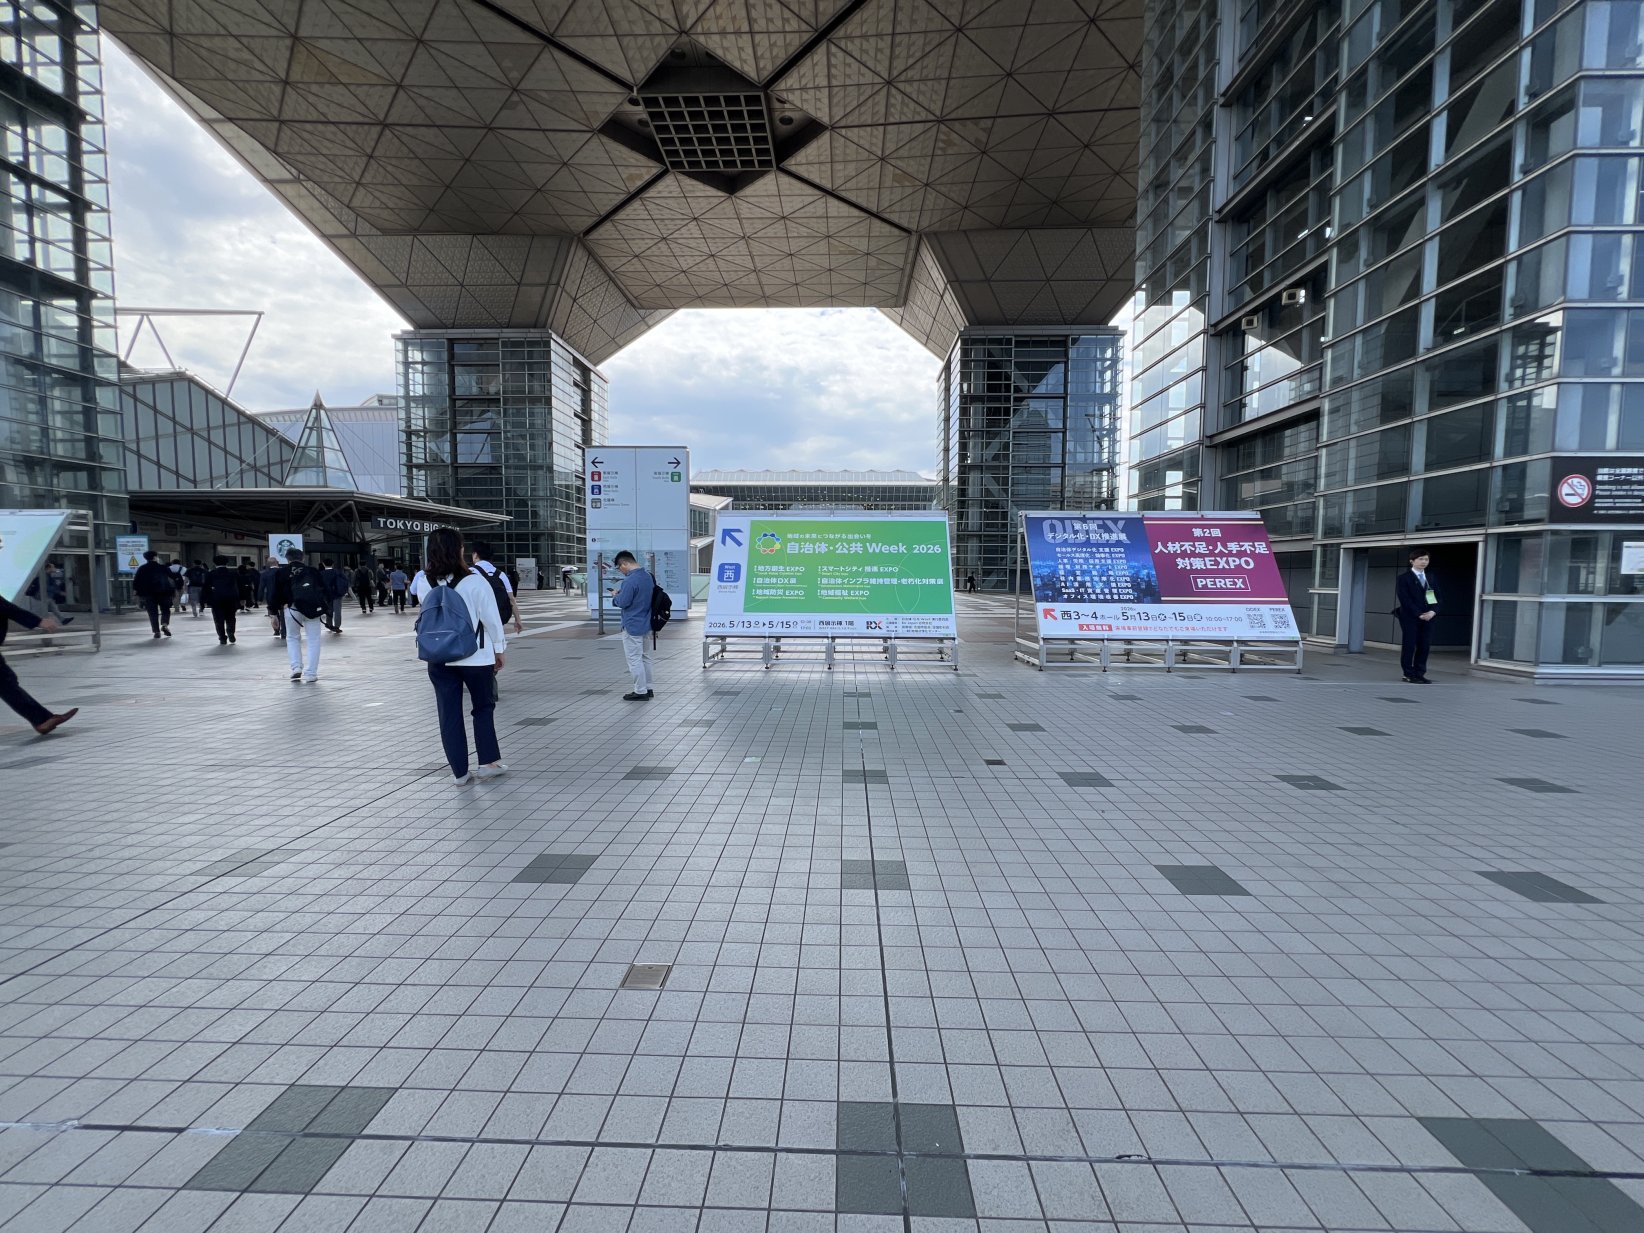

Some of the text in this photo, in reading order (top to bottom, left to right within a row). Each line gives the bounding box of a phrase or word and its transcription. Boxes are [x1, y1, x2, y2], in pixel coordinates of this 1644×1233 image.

[377, 518, 421, 531] TOKYO
[424, 523, 439, 532] BIG
[1192, 528, 1222, 537] 第2回
[787, 542, 941, 554] 自治体・公共 Week 2026
[1155, 542, 1269, 554] 人材不足・人手不足
[1176, 557, 1254, 569] 対策EXPO
[724, 570, 735, 581] 西
[1197, 578, 1245, 588] PEREX
[729, 620, 752, 628] 5/13
[768, 620, 792, 628] 5/15
[866, 620, 882, 629] RX
